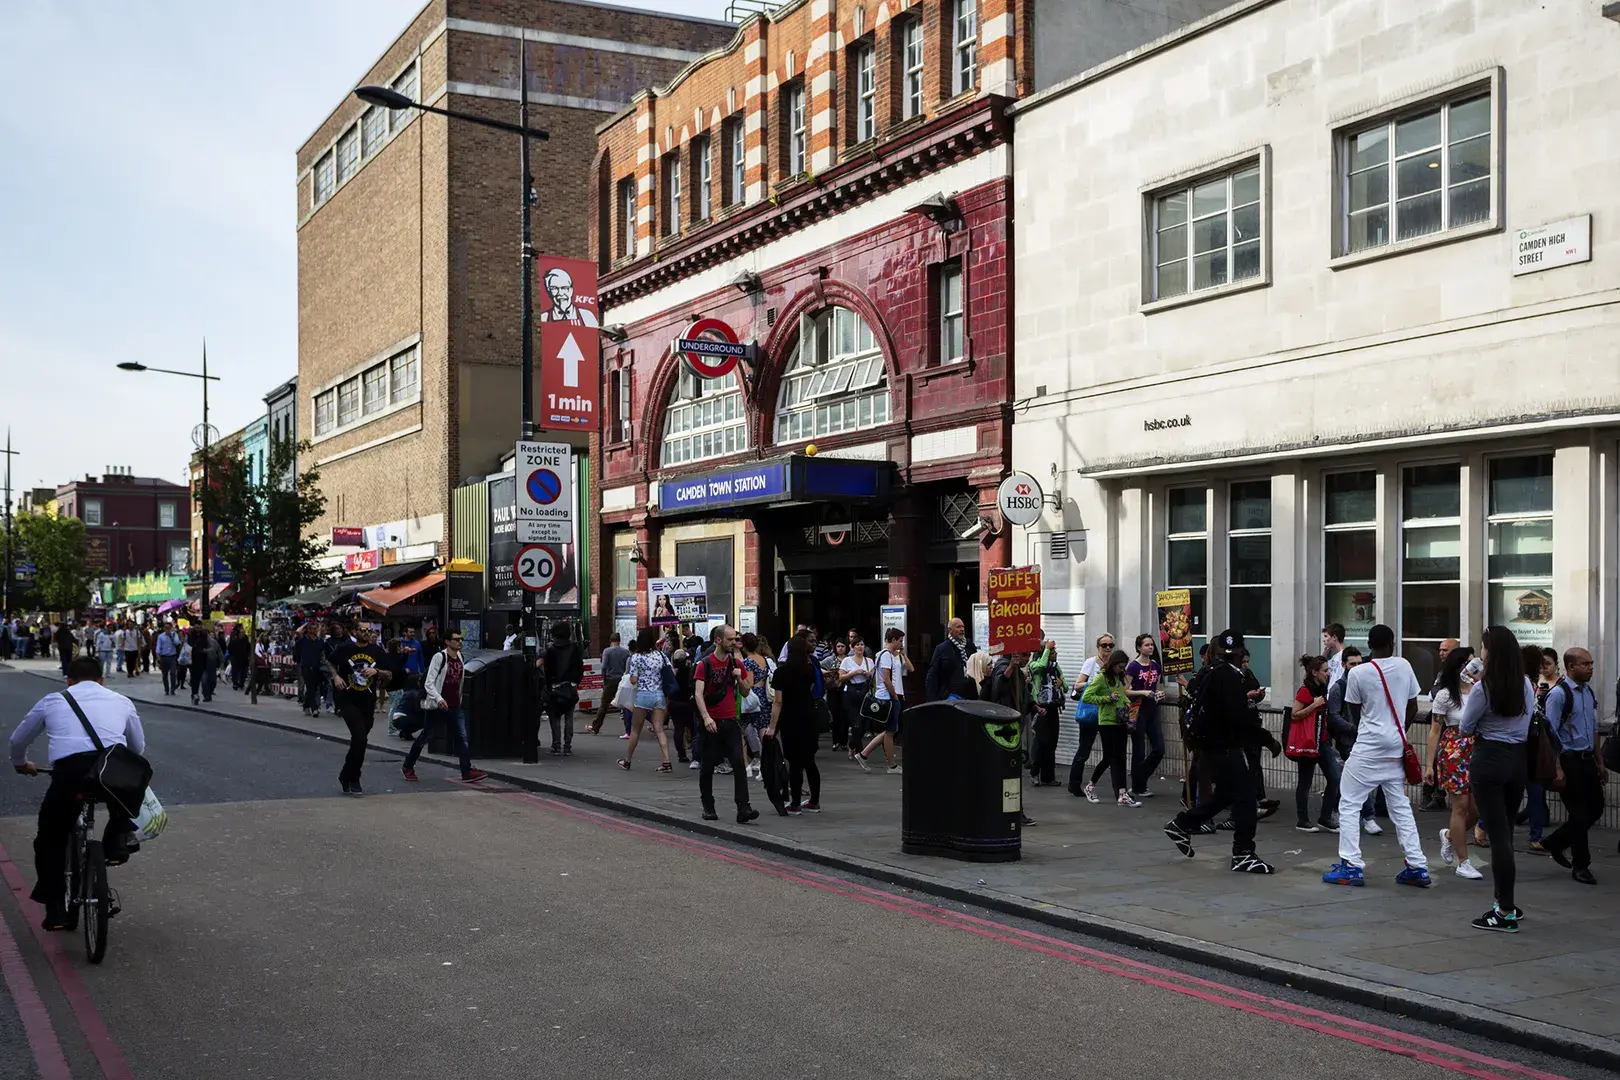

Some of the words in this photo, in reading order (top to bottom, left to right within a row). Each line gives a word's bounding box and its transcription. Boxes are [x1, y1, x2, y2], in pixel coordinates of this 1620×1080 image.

[1519, 237, 1547, 252] CAMDEN
[1549, 233, 1566, 245] HIGH
[1519, 252, 1543, 265] STREET
[575, 295, 595, 305] KFC
[681, 340, 744, 355] UNDERGROUND
[548, 393, 556, 409] 1
[558, 394, 592, 412] min
[1143, 414, 1192, 431] hsbc.co.uk
[520, 444, 567, 455] Restricted
[526, 455, 560, 466] ZONE
[676, 482, 707, 502] CAMDEN
[708, 478, 732, 498] TOWN
[734, 474, 766, 493] STATION
[1007, 496, 1039, 510] HSBC
[494, 506, 510, 523] PAUL
[520, 507, 533, 516] No
[536, 507, 569, 518] loading
[521, 558, 553, 578] 20
[989, 571, 1039, 589] BUFFET
[989, 597, 1040, 619] takeout
[995, 623, 1033, 638] £3.50
[1486, 916, 1498, 926] N
